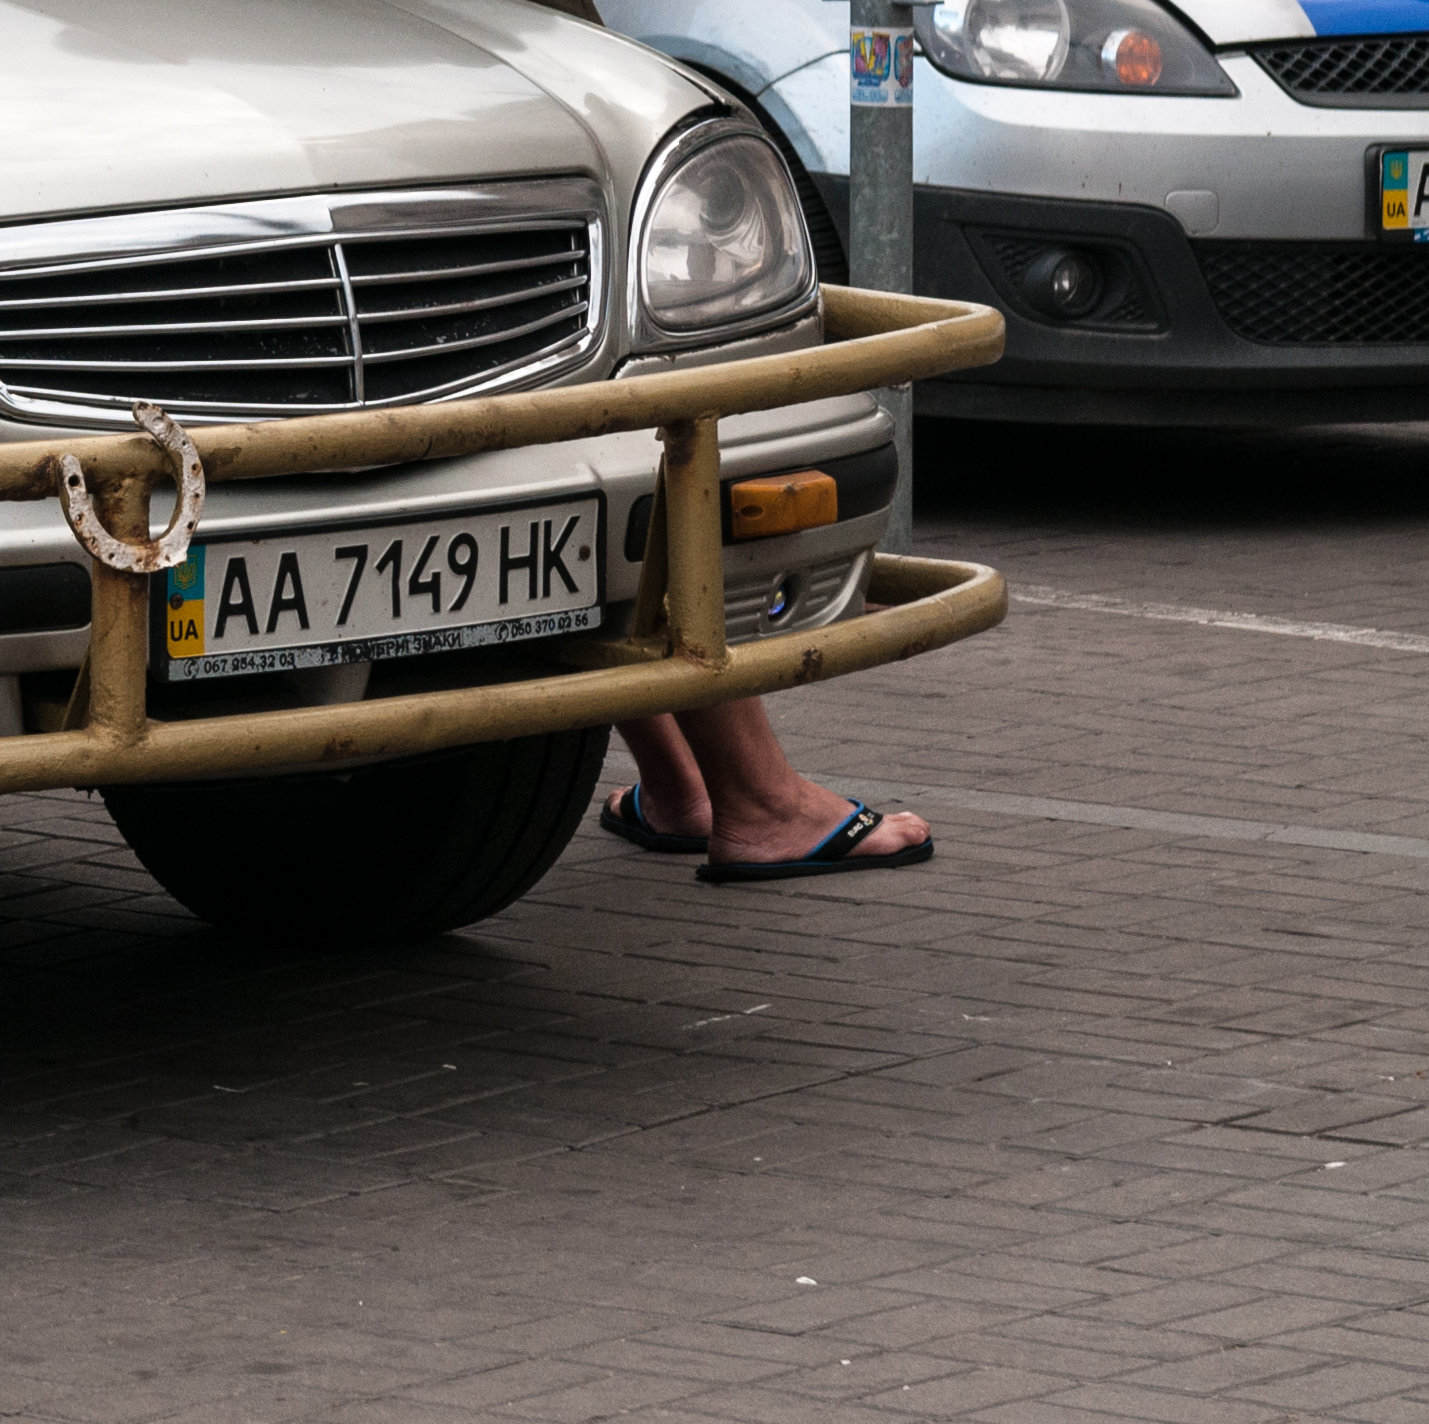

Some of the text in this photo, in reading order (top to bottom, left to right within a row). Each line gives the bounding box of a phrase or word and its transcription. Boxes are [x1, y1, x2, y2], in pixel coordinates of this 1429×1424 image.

[1386, 200, 1406, 218] UA
[213, 515, 581, 639] AA 7149 HK
[169, 618, 199, 643] UA
[203, 660, 228, 674] 067
[259, 654, 276, 669] 32
[535, 618, 556, 634] 370
